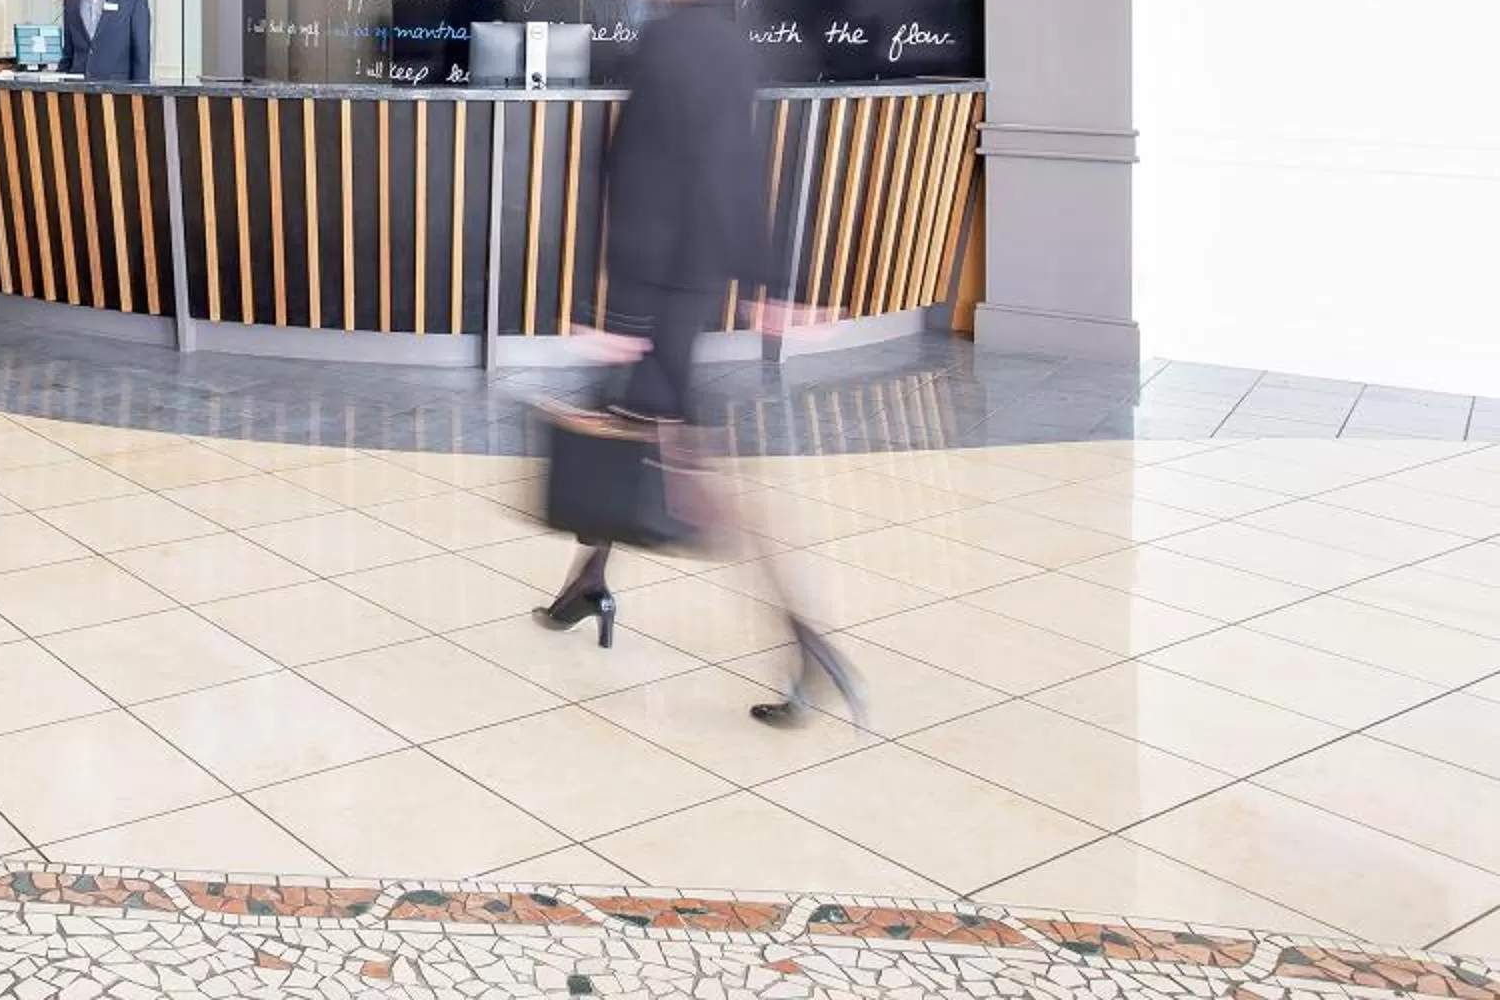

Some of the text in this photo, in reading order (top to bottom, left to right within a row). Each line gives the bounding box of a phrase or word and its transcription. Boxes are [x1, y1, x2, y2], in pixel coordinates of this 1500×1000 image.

[394, 20, 472, 41] mantra
[749, 20, 802, 44] with
[825, 21, 869, 45] the
[389, 60, 430, 87] keep
